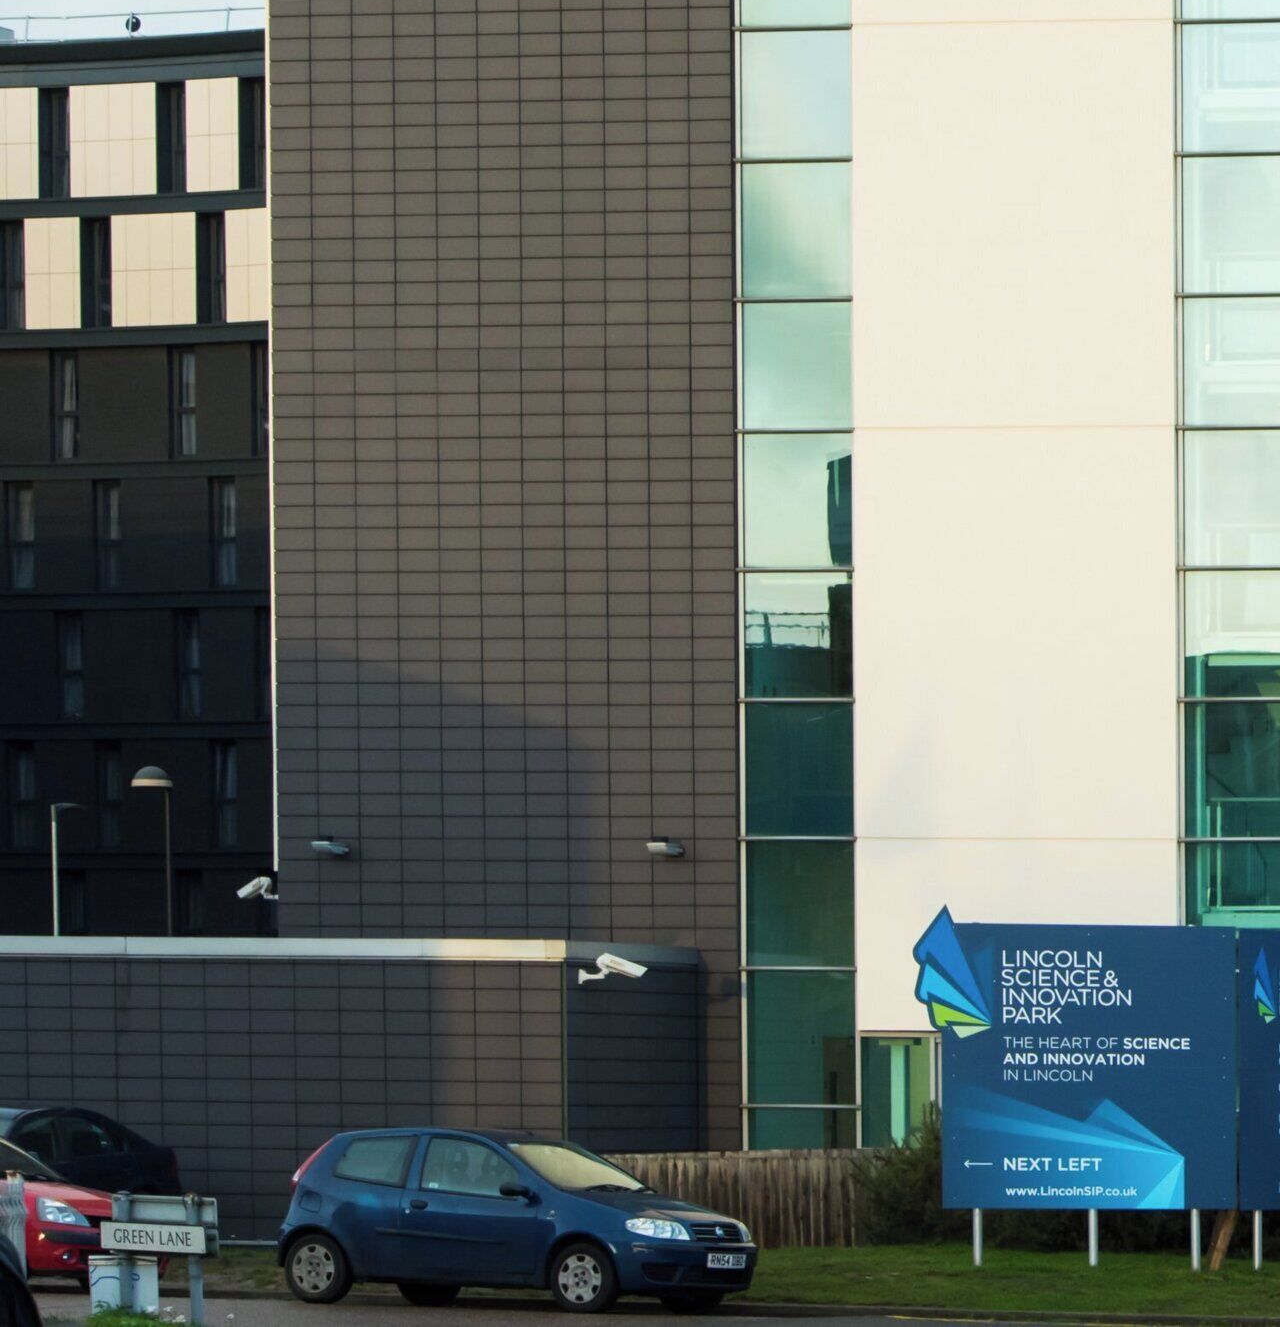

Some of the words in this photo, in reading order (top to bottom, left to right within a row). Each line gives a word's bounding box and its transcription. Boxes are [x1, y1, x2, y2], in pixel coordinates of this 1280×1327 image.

[1002, 949, 1102, 968] LINCOLN
[1001, 969, 1100, 987] SCIENCE
[1103, 970, 1119, 988] &
[1002, 988, 1132, 1006] INNOVATION
[1003, 1007, 1062, 1024] PARK
[1003, 1036, 1034, 1049] THE
[1039, 1036, 1092, 1049] HEART
[1096, 1037, 1119, 1050] OF
[1123, 1037, 1191, 1050] SCIENCE
[1003, 1053, 1039, 1065] AND
[1043, 1053, 1145, 1066] INNOVATION
[1003, 1069, 1018, 1082] IN
[1024, 1069, 1093, 1082] LINCOLN
[1003, 1157, 1052, 1171] NEXT
[1058, 1157, 1102, 1172] LEFT
[1005, 1186, 1137, 1197] www.LincolnSIP.co.uk
[113, 1228, 154, 1244] GREEN
[159, 1231, 192, 1247] LANE
